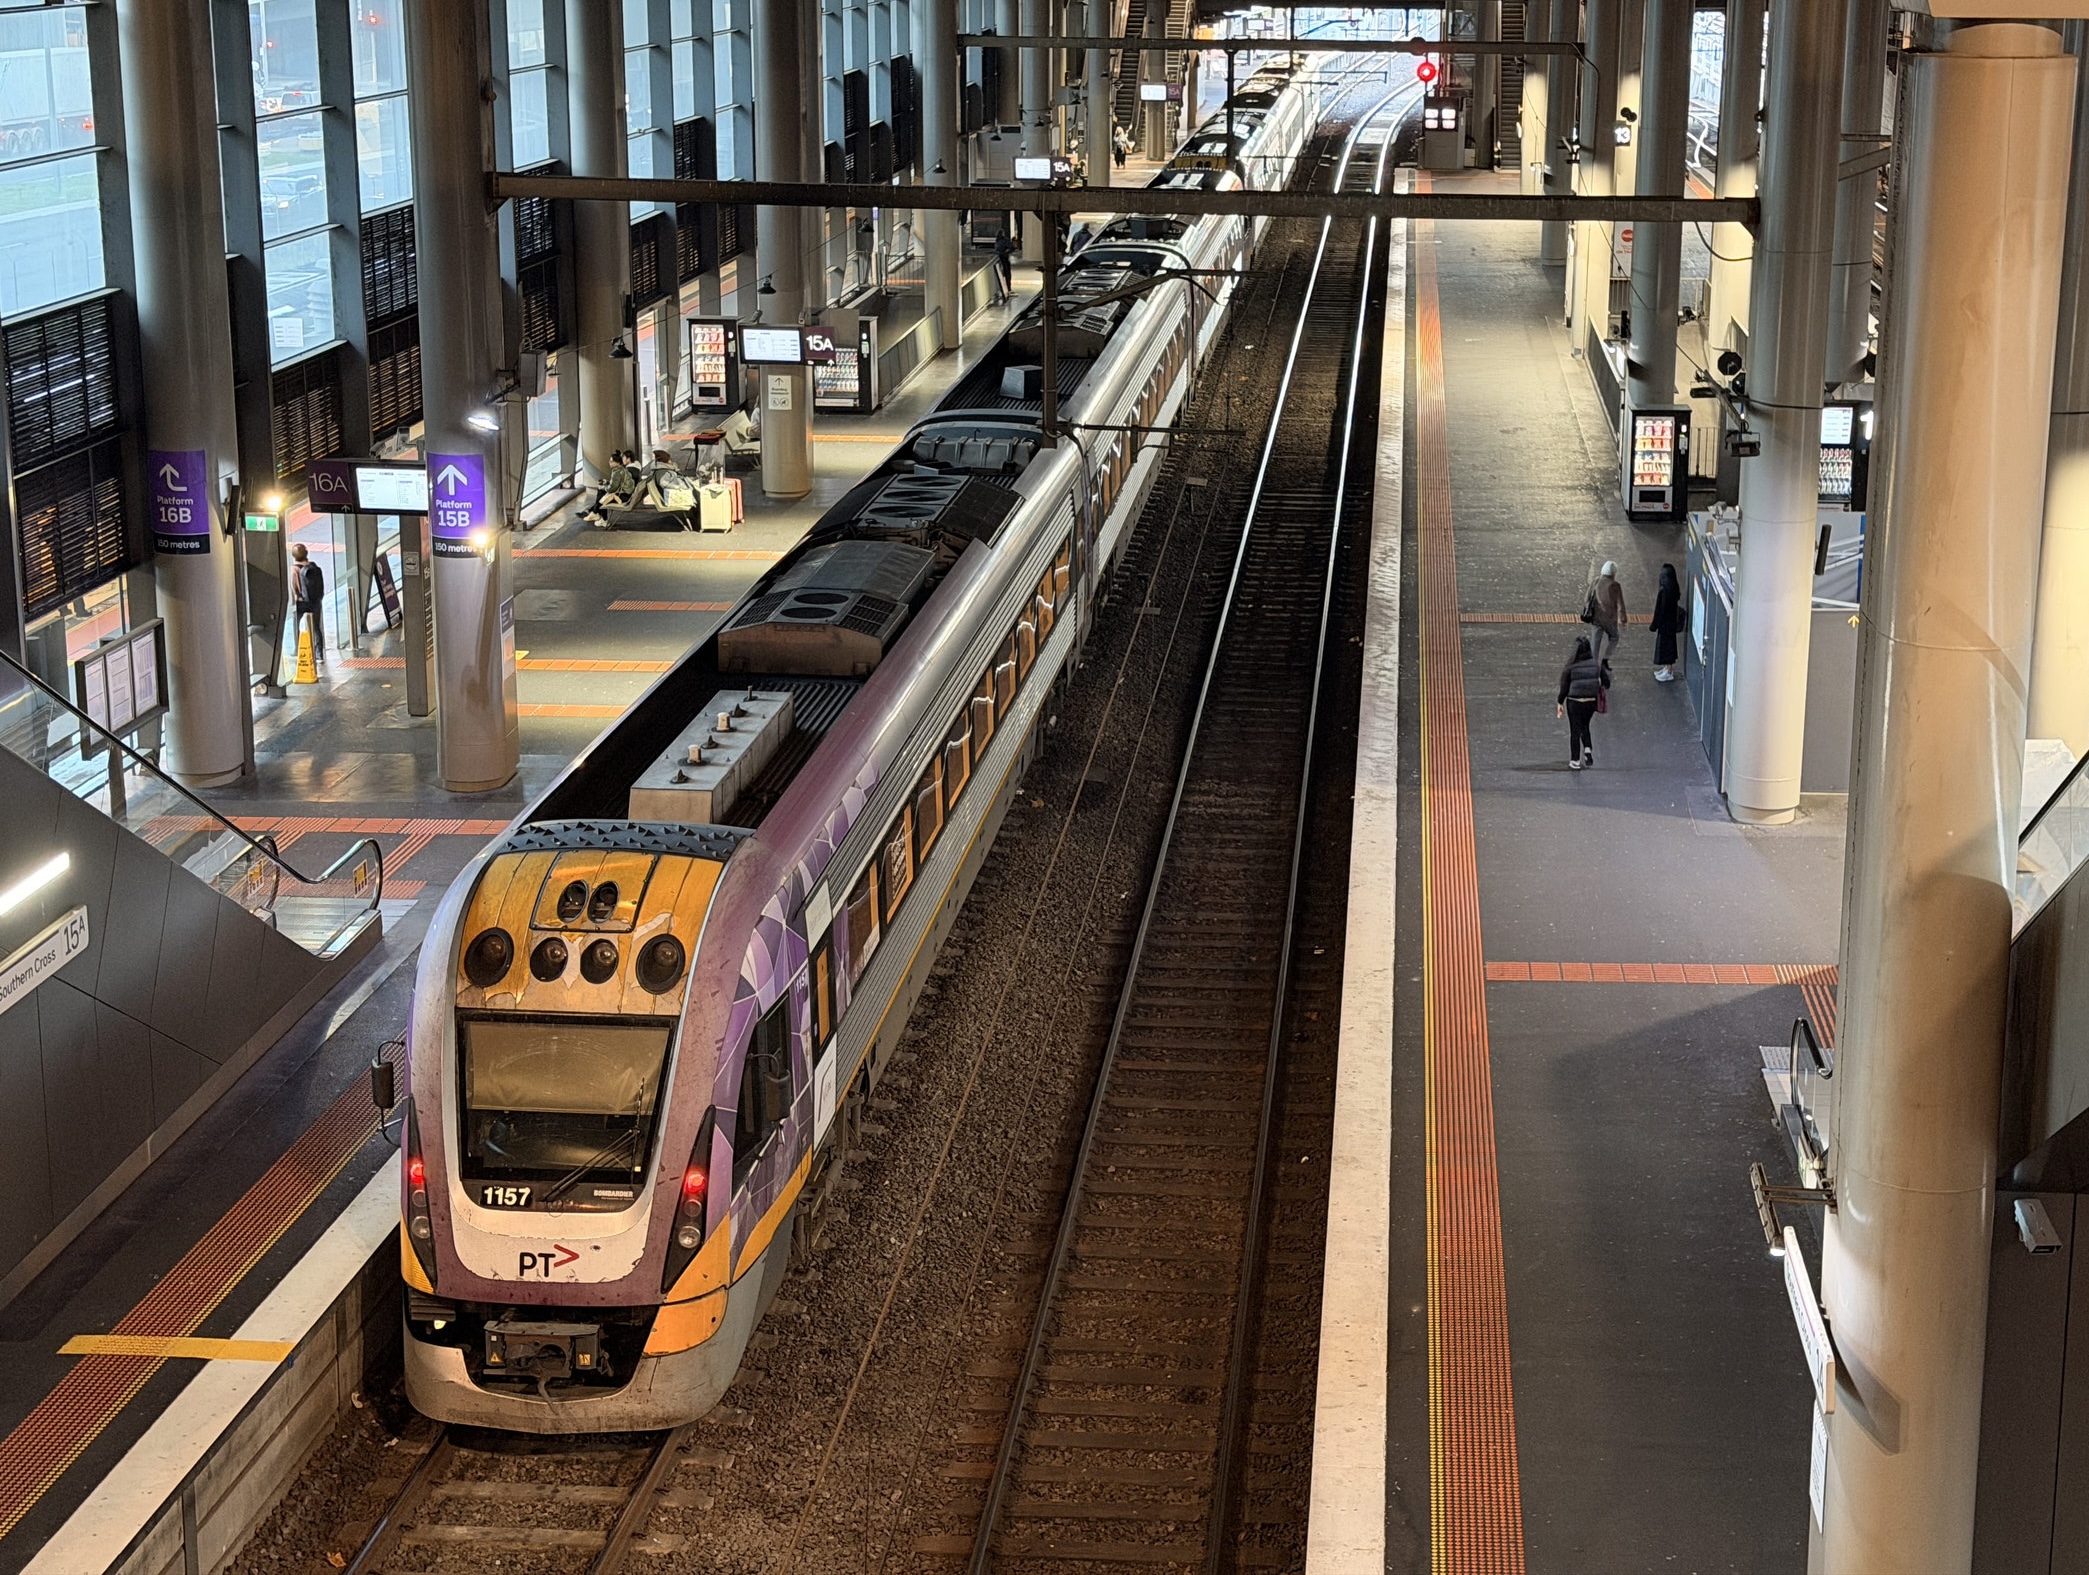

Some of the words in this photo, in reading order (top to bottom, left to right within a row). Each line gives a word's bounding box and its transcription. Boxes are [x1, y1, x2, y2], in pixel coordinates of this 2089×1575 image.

[1053, 161, 1070, 172] 15A
[806, 335, 834, 351] 15A
[1860, 410, 1874, 440] 1
[309, 472, 348, 493] 16A
[157, 495, 194, 506] Platform
[436, 499, 472, 510] Platform
[160, 507, 192, 523] 16B
[438, 511, 470, 527] 15B
[157, 539, 169, 548] 150
[170, 541, 200, 549] metres
[435, 542, 447, 552] 150
[0, 966, 34, 1001] Southern
[34, 949, 56, 973] Cross
[63, 915, 86, 956] 15A
[484, 1187, 531, 1206] 1157
[593, 1189, 634, 1198] BOMBARDIER
